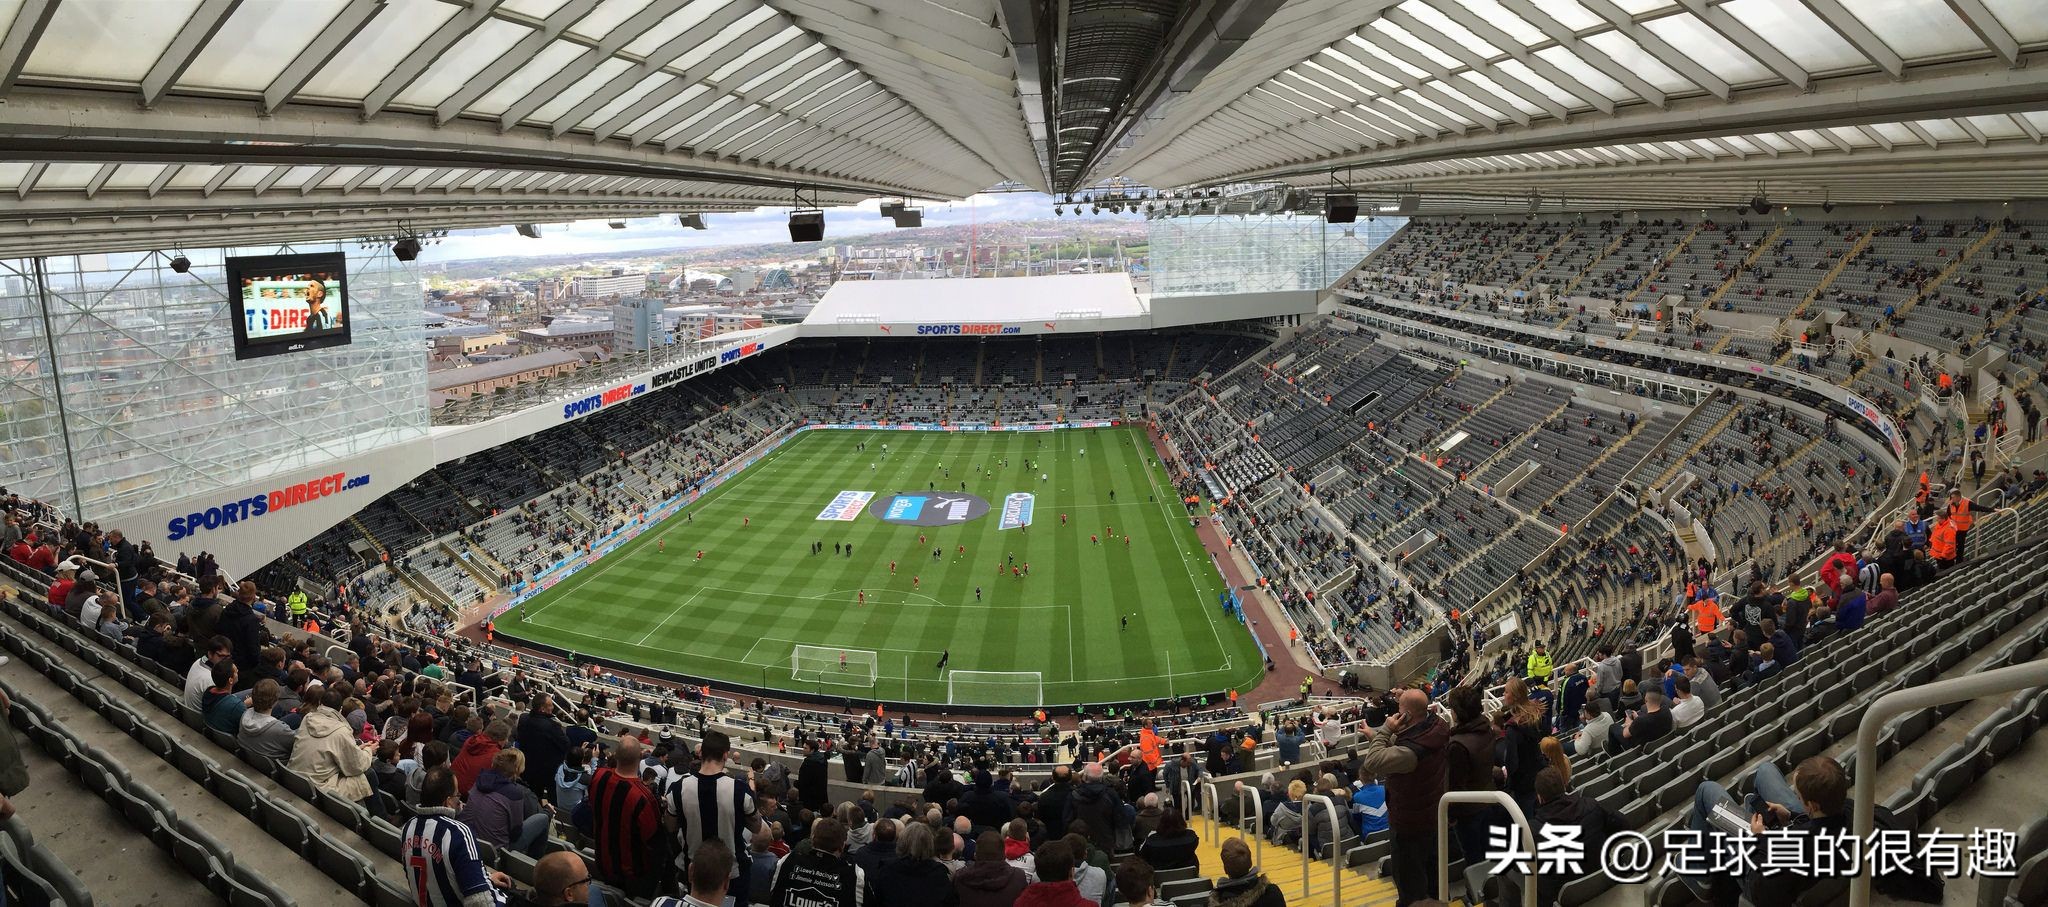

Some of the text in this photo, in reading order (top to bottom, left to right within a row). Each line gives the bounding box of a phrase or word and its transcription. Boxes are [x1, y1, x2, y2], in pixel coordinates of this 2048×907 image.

[651, 355, 717, 388] NEWCASTLE UNITED
[821, 491, 858, 519] SPORTS
[410, 855, 427, 907] 7
[814, 878, 835, 888] Johnson
[815, 870, 833, 880] Racing
